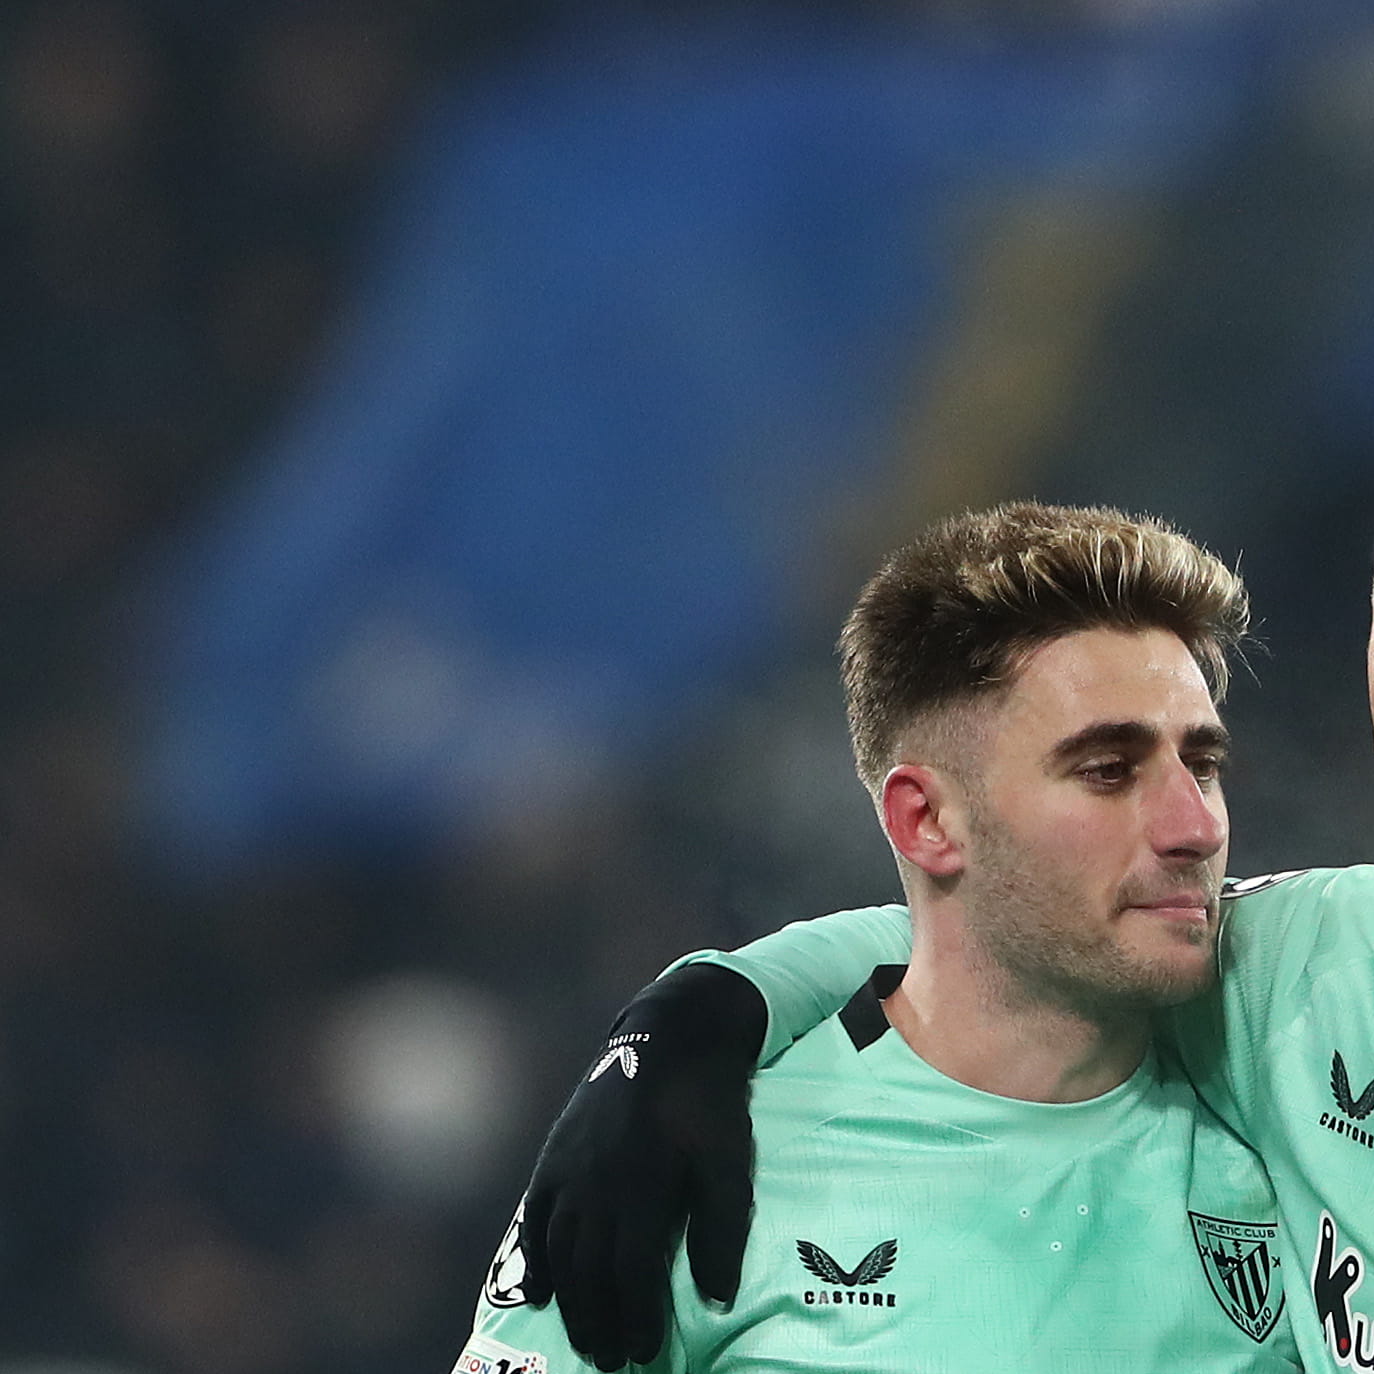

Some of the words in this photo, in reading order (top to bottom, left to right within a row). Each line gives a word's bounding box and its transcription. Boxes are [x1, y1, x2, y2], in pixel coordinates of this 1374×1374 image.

[1319, 1112, 1374, 1149] CASTORE
[1197, 1220, 1242, 1236] ATHLETIC
[1244, 1228, 1276, 1239] CLUB
[804, 1291, 896, 1307] CASTORE
